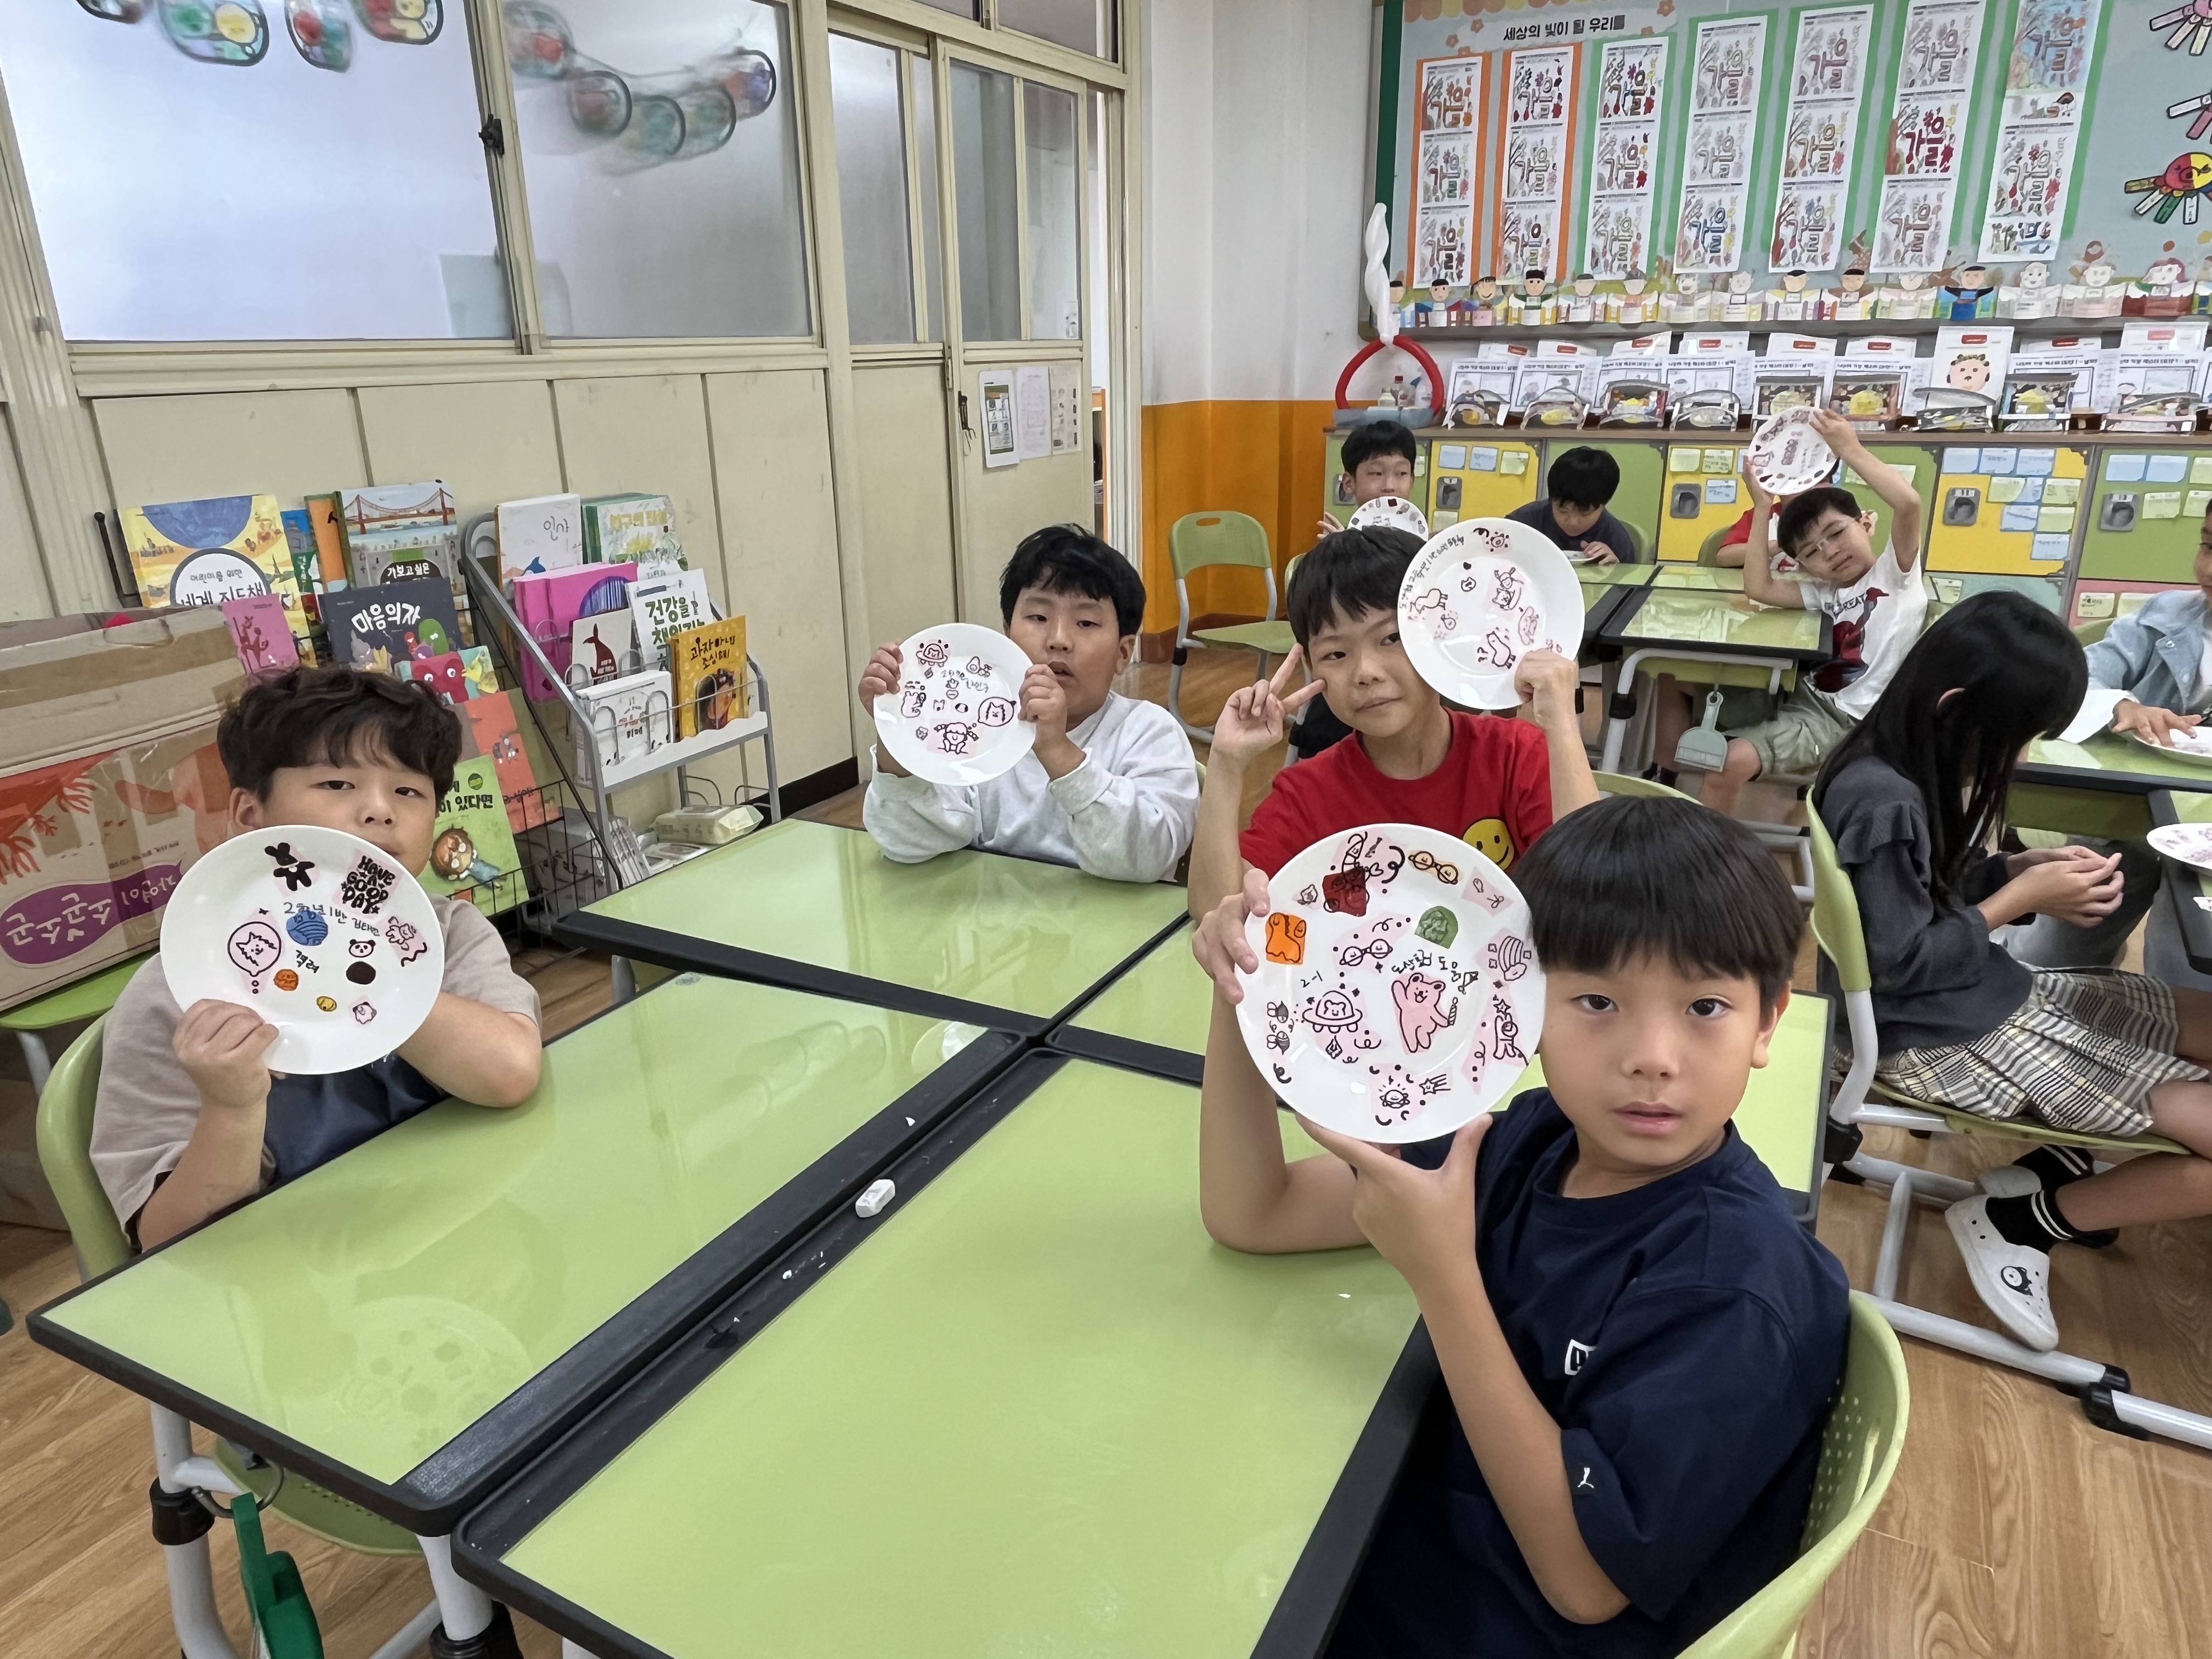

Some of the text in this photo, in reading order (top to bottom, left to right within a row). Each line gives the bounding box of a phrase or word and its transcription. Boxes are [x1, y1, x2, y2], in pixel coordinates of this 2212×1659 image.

[1503, 24, 1541, 41] 세상의
[1545, 21, 1568, 37] 빛이
[1708, 49, 1743, 99] 가을
[1810, 38, 1847, 89] 가을
[1431, 86, 1464, 127] 가을
[1518, 77, 1553, 119] 가을
[1609, 70, 1645, 115] 가을
[1797, 123, 1835, 172] 가을
[1905, 116, 1943, 166] 가을
[1430, 154, 1460, 198] 가을
[1605, 144, 1640, 188] 가을
[1427, 227, 1458, 269] 가을
[1689, 207, 1725, 253] 가을
[1786, 205, 1824, 251] 가을
[1890, 203, 1930, 252] 가을
[544, 516, 569, 541] 인사
[645, 596, 690, 625] 건강을
[455, 794, 493, 812] 있다면
[347, 871, 389, 901] GOOD
[358, 855, 396, 887] HAVE A
[6, 876, 176, 945] 자연이 소곤소곤
[342, 886, 382, 914] DAY
[1300, 970, 1323, 988] 2-1
